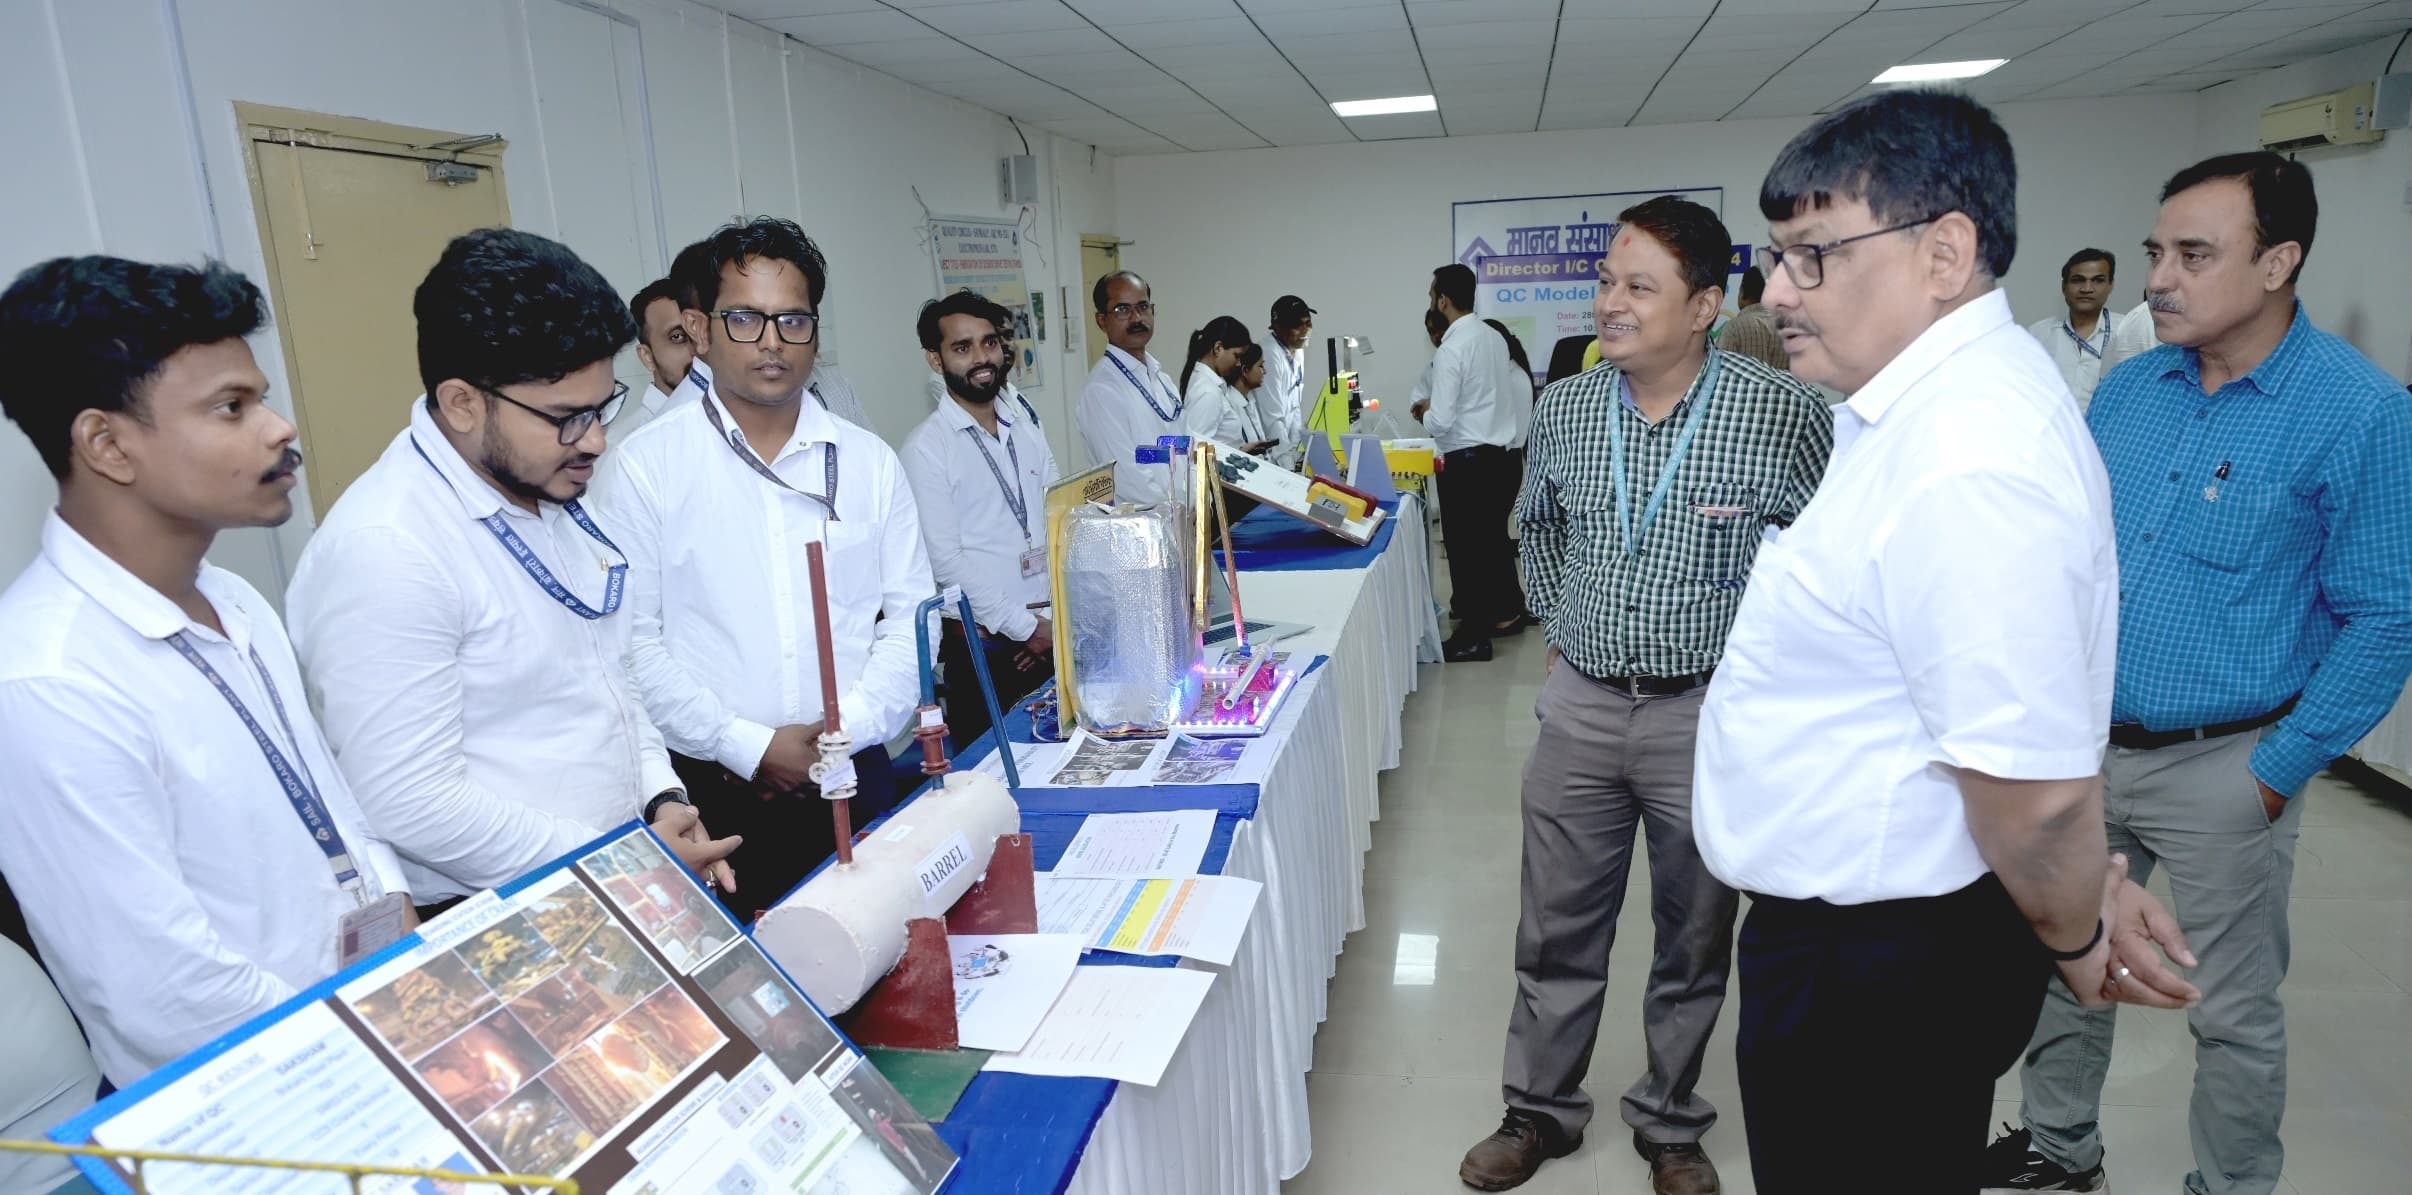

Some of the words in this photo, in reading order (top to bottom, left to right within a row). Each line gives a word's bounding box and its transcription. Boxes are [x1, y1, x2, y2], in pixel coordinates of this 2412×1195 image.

[1486, 262, 1560, 276] Director
[1565, 260, 1588, 274] I/C
[1496, 288, 1527, 303] QC
[1557, 312, 1578, 320] Date:
[1557, 325, 1580, 334] Time:
[609, 573, 620, 608] BOKARO
[224, 687, 250, 721] PLANT
[250, 721, 272, 756] STEEL
[272, 755, 302, 799] BOKARO
[920, 845, 967, 892] BARREL
